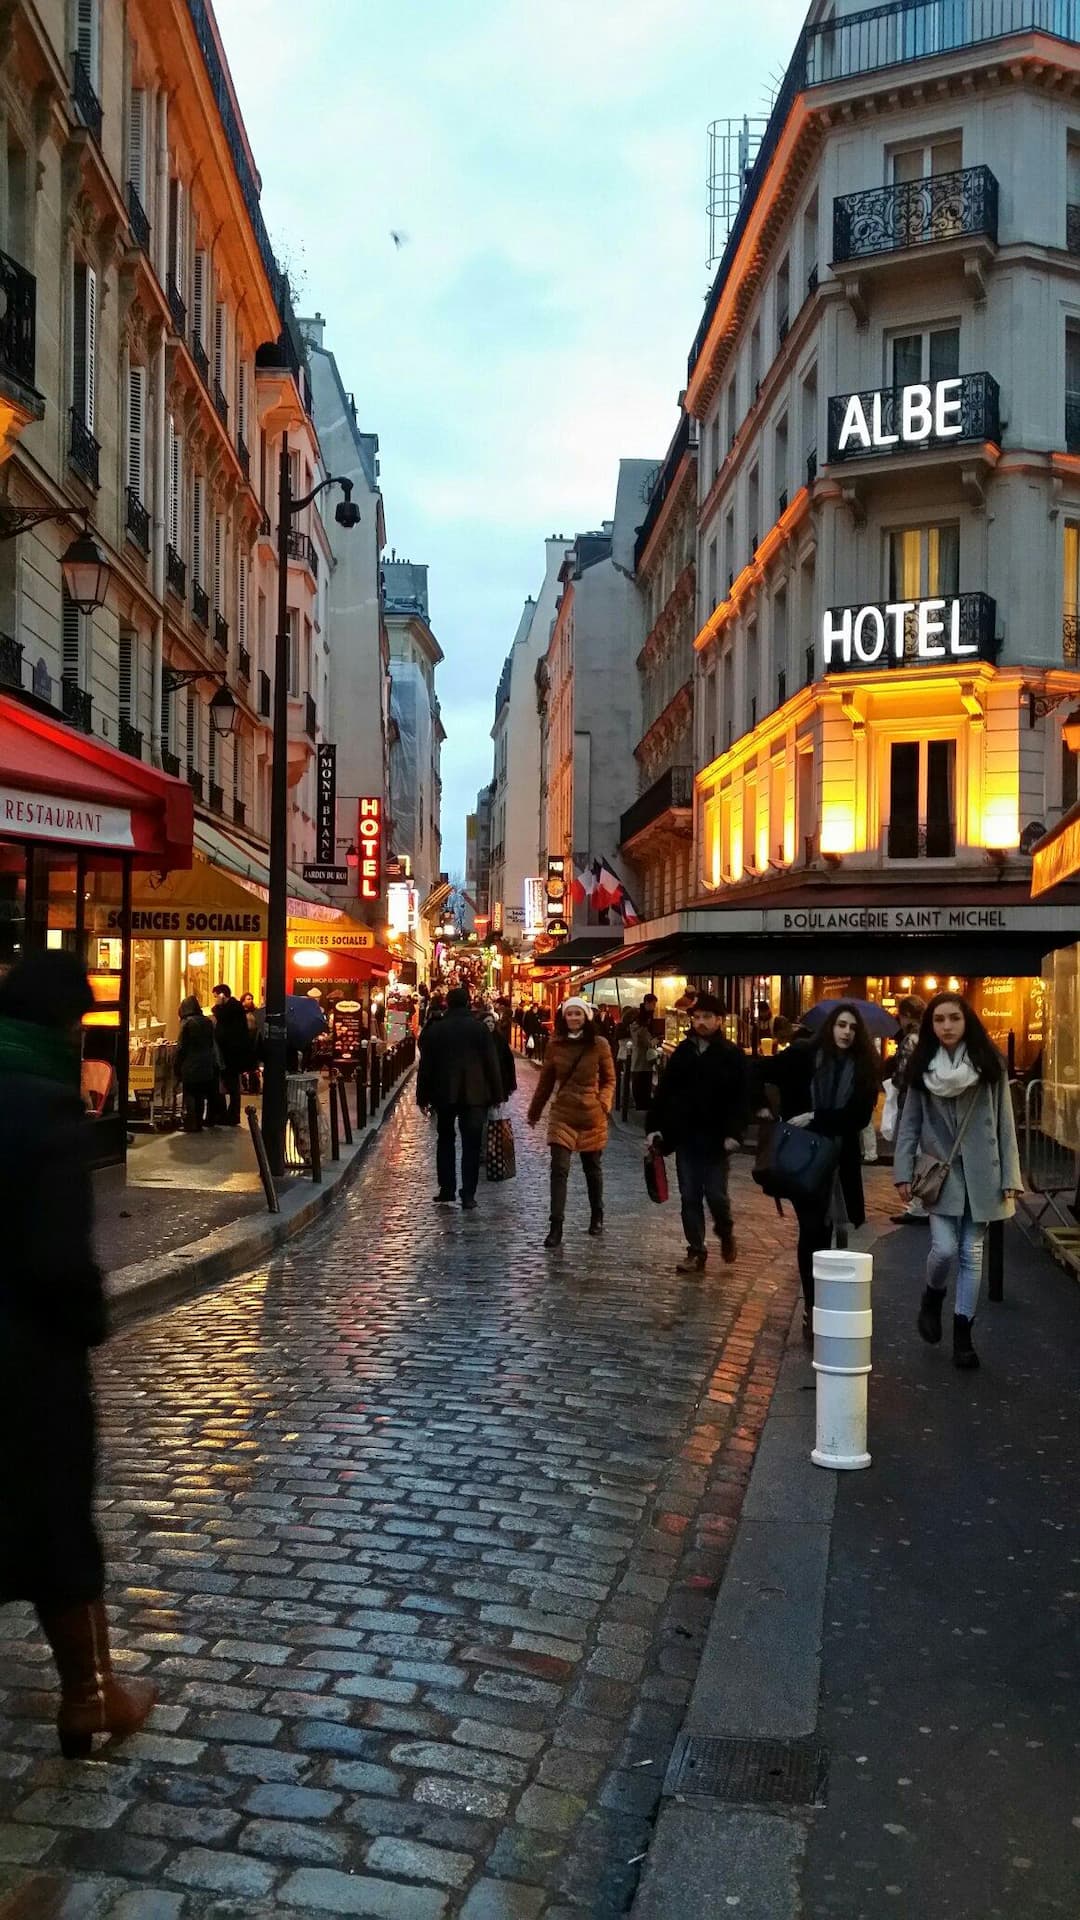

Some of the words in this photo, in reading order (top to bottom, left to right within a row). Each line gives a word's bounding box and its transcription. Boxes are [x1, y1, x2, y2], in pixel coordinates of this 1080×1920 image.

[838, 378, 963, 450] ALBE
[823, 600, 978, 663] HOTEL
[321, 758, 332, 797] MONT
[6, 799, 102, 833] RESTAURANT
[321, 806, 331, 860] BLANC
[360, 799, 379, 897] HOTEL
[304, 870, 326, 879] JARDIN
[327, 871, 335, 880] DU
[336, 872, 347, 880] ROI
[107, 911, 180, 931] SCENCES
[186, 912, 261, 932] SOCIALES
[784, 912, 889, 928] BOULANGERIE
[895, 911, 942, 927] SAINT
[949, 911, 1006, 927] MICHEL
[293, 935, 329, 945] SCIENCES
[332, 935, 367, 945] SOCIALES
